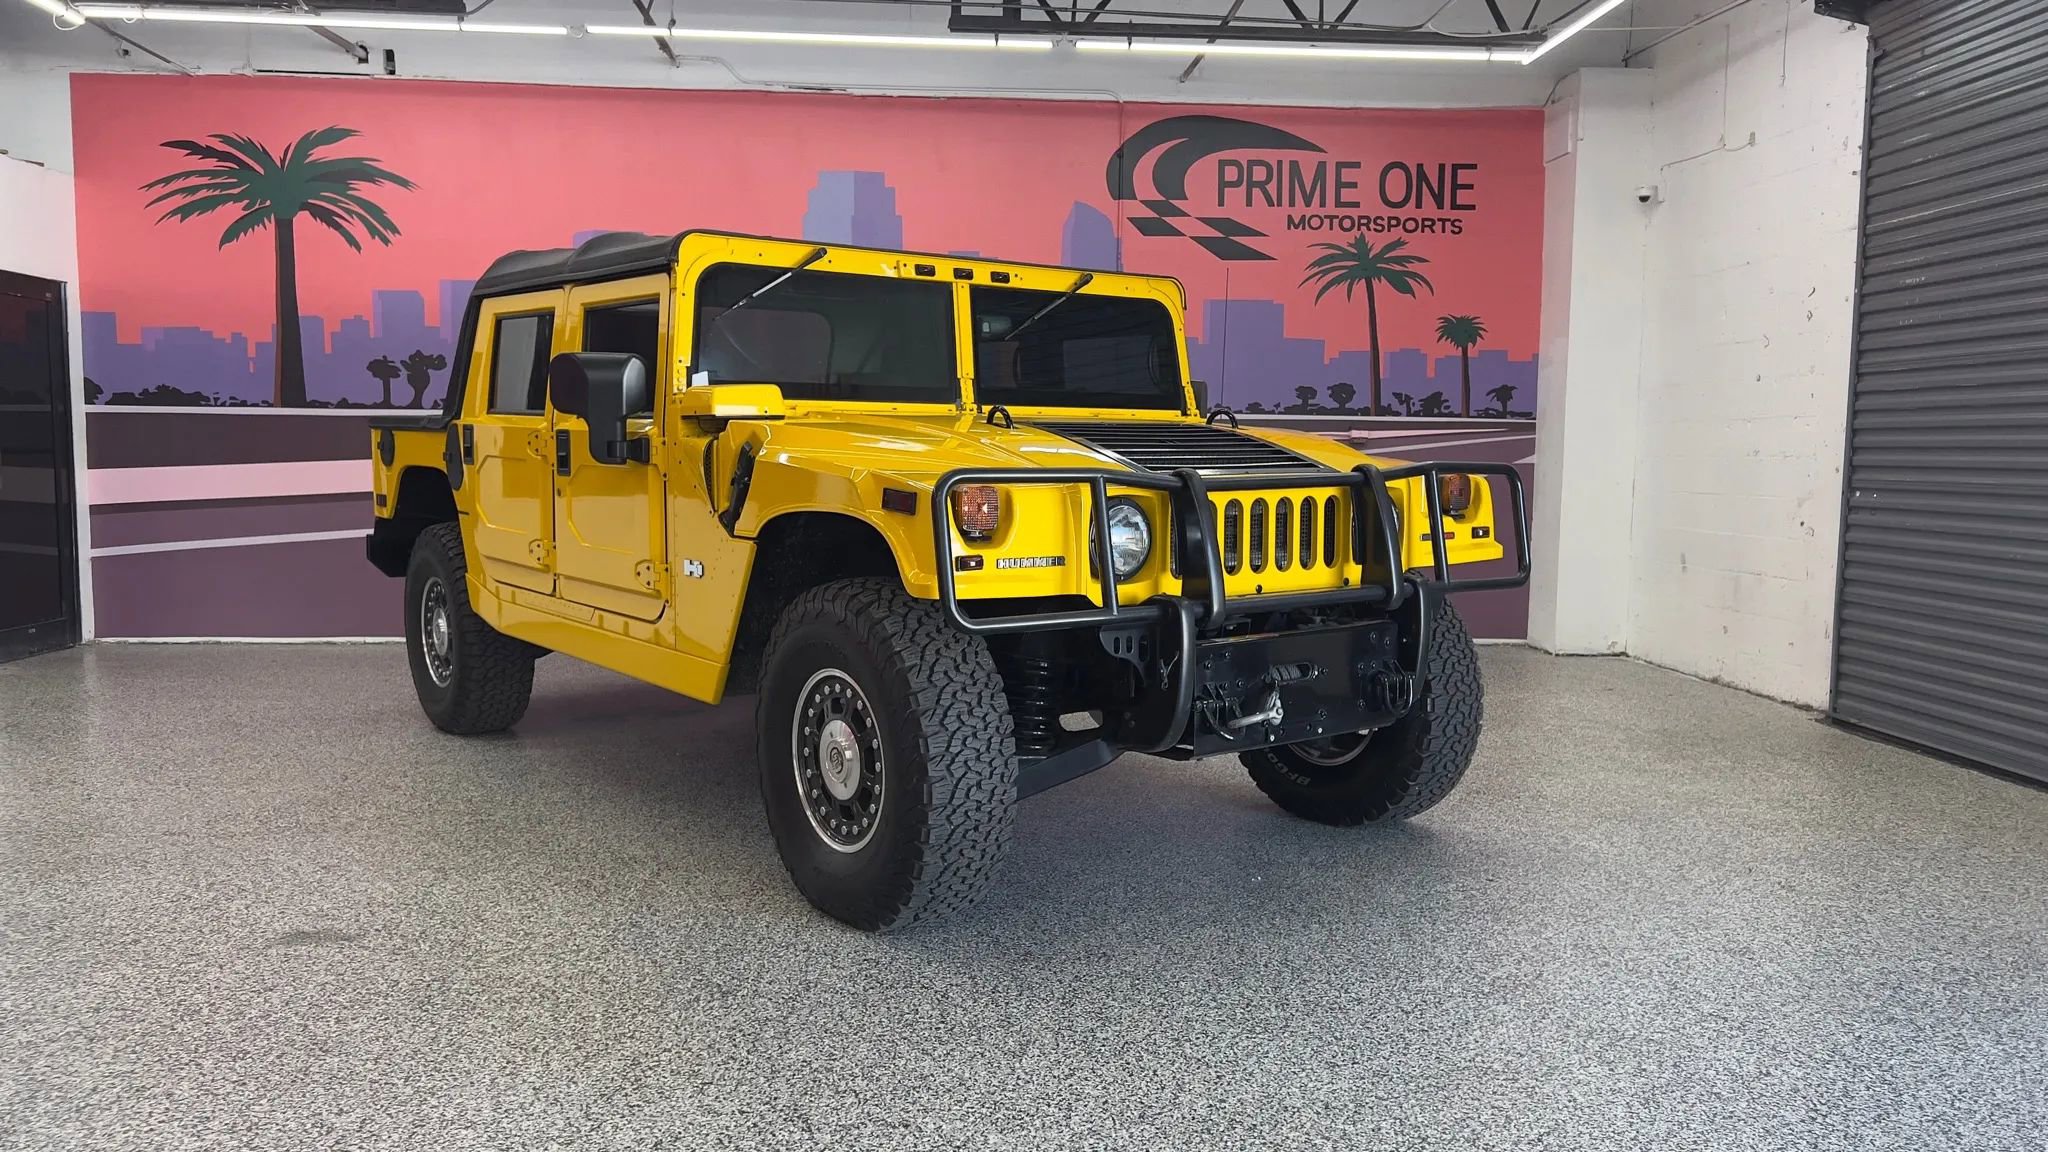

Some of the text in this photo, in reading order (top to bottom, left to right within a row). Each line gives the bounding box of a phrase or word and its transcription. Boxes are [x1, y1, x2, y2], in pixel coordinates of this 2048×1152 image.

[1217, 159, 1478, 211] PRIME ONE
[1286, 214, 1463, 235] MOTORSPORTS
[996, 556, 1066, 569] HUMMER
